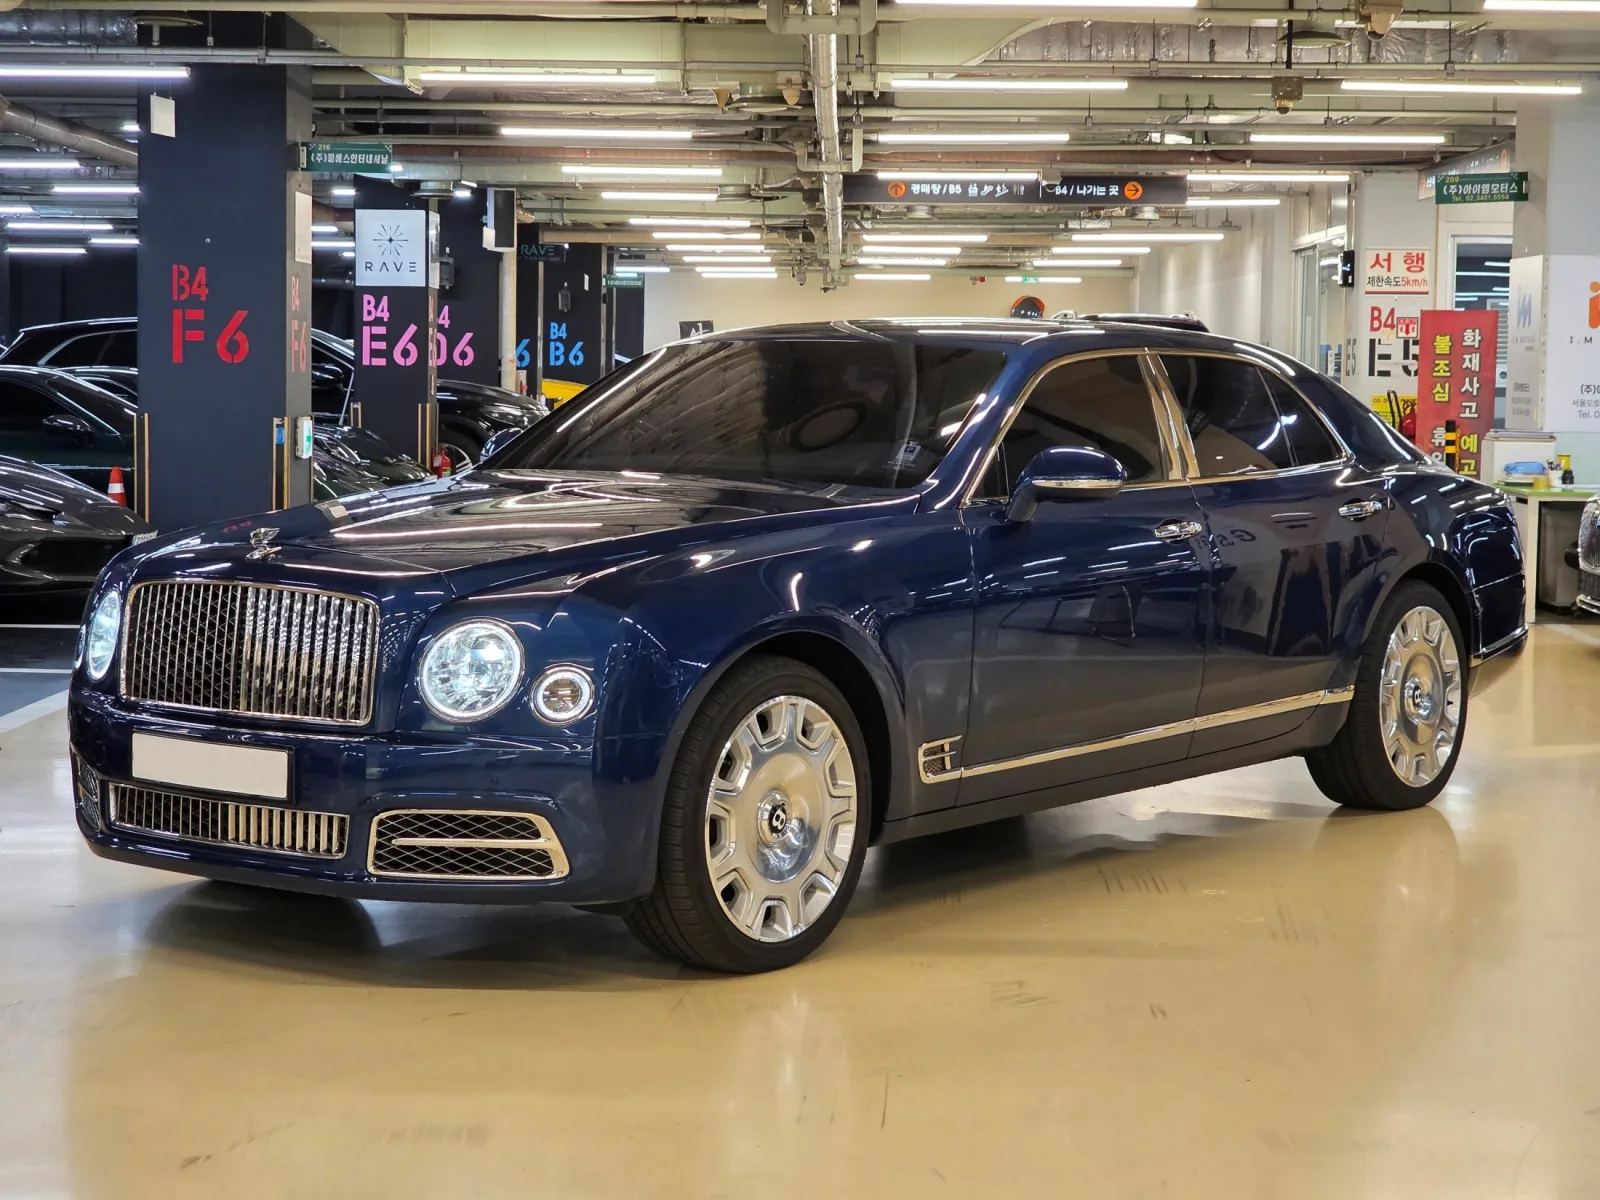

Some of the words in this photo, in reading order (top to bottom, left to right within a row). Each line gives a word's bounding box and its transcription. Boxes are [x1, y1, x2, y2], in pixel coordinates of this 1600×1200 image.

[317, 143, 331, 151] 216
[1076, 185, 1106, 196] 나가는
[1108, 185, 1119, 196] 곳
[1443, 182, 1519, 196] (주)아이엠모터스
[364, 261, 417, 273] RAVE
[172, 264, 209, 301] B4
[362, 294, 390, 322] B4
[437, 304, 450, 329] 4
[1369, 305, 1397, 332] B4
[550, 321, 568, 340] B4
[1431, 335, 1452, 402] 불조심
